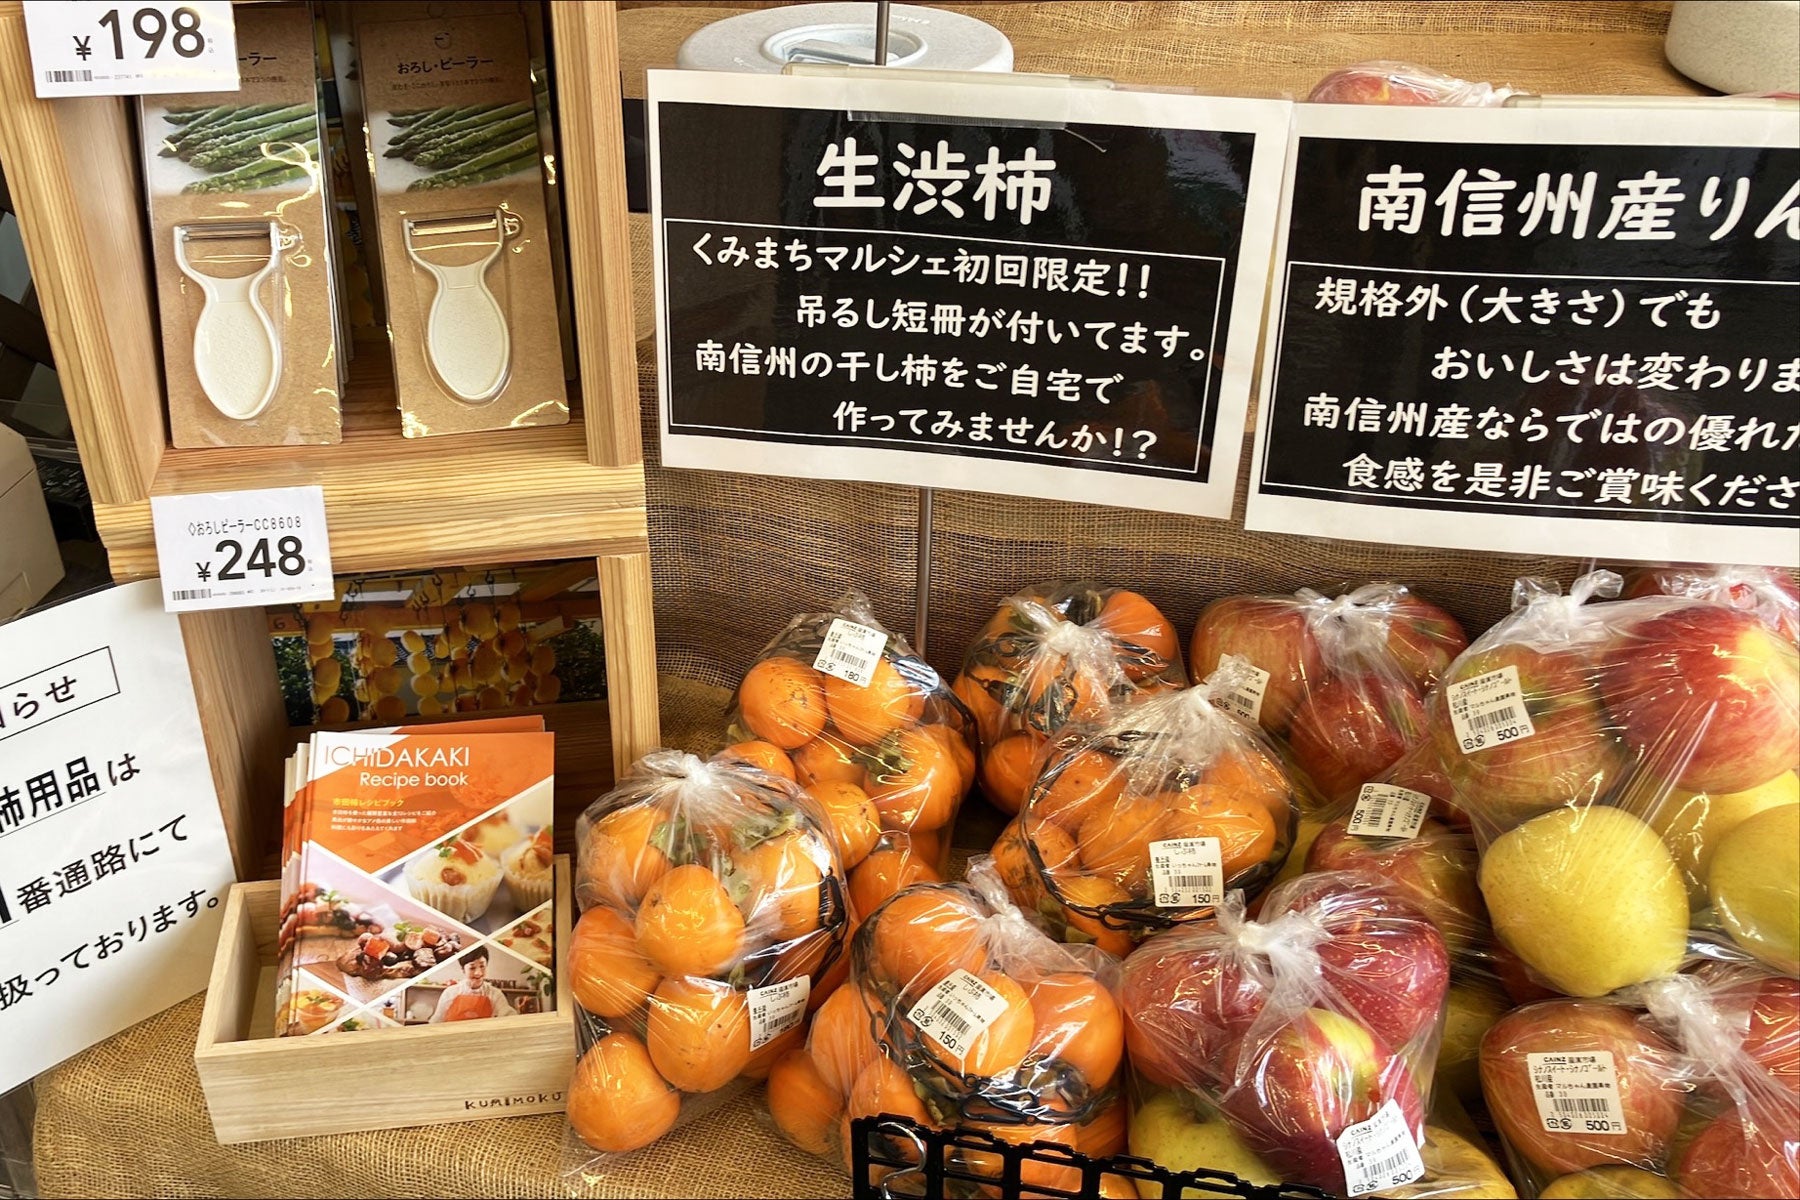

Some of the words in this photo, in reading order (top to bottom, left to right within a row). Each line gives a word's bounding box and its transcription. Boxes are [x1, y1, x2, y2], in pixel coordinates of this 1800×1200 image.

[73, 6, 205, 61] ¥198
[397, 55, 494, 74] おろし・ピーラー
[813, 137, 1056, 225] 生渋柿
[692, 232, 1151, 299] くみまちマルシェ初回限定!!
[796, 294, 1205, 361] 吊るし短冊が付いてます。
[695, 338, 1125, 404] 南信州の干し柿をご自宅で
[832, 400, 1158, 460] 作ってみませんか!?
[1342, 452, 1800, 509] 食感を是非ご賞味くださ
[196, 535, 306, 582] ¥248
[0, 676, 77, 728] らせ
[324, 746, 470, 768] ICHIDAKAKI
[360, 772, 420, 789] Recipe
[425, 772, 469, 786] book
[465, 1091, 563, 1110] KUMIMOKU
[1586, 1120, 1622, 1131] 500円
